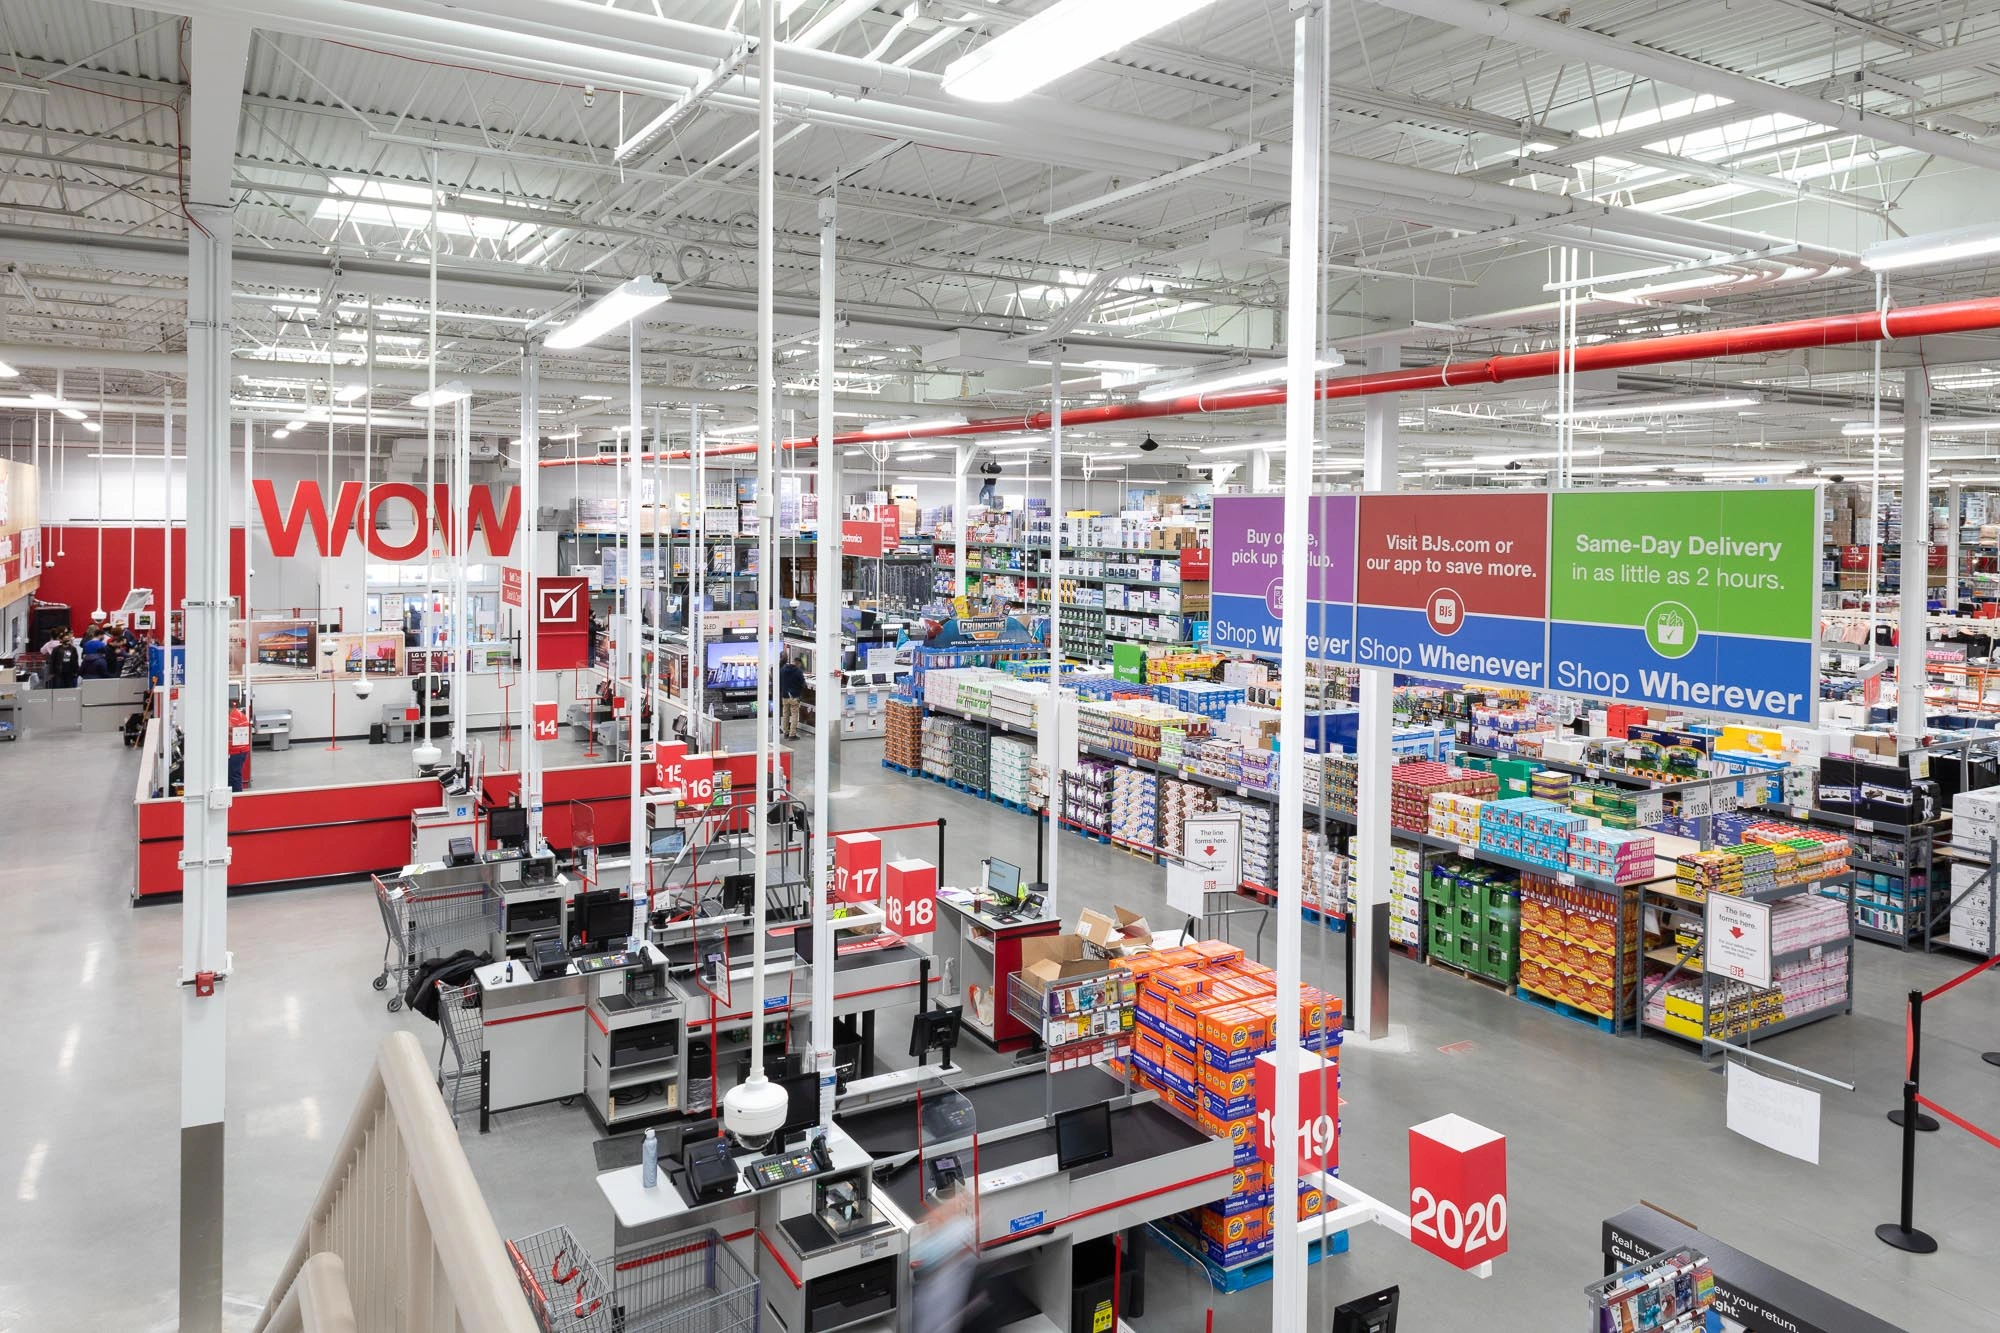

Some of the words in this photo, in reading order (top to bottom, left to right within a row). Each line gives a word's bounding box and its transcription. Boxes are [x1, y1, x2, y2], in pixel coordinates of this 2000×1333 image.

[252, 479, 521, 561] WOW
[1247, 528, 1271, 547] Buy
[1386, 534, 1418, 551] Visit
[1421, 535, 1490, 553] BJs.com
[1495, 540, 1514, 554] or
[1196, 550, 1203, 560] 1
[1231, 548, 1259, 567] pick
[1261, 553, 1278, 568] up
[1576, 534, 1683, 559] Same-Day
[1688, 535, 1782, 562] Delivery
[1366, 557, 1391, 571] our
[1394, 559, 1422, 575] app
[1426, 557, 1442, 573] to
[1446, 561, 1483, 575] save
[1488, 563, 1537, 578] more.
[1571, 562, 1587, 581] in
[1593, 567, 1615, 582] as
[1621, 564, 1661, 584] little
[1666, 570, 1691, 585] as
[1696, 567, 1709, 586] 2
[1717, 567, 1785, 590] hours.
[1216, 620, 1257, 649] Shop
[1359, 636, 1412, 669] Shop
[1418, 643, 1543, 681] Whenever
[1557, 660, 1630, 698] Shop
[1638, 668, 1803, 715] Wherever
[536, 719, 557, 736] 14
[689, 778, 712, 798] 16
[1644, 810, 1662, 823] $16.99
[1690, 802, 1708, 816] $13.99
[836, 865, 848, 893] 17
[852, 867, 879, 894] 17
[886, 895, 902, 926] 18
[904, 897, 934, 927] 18
[1725, 906, 1738, 915] The
[1739, 910, 1752, 919] line
[1719, 914, 1739, 926] forms
[1739, 919, 1758, 930] here.
[1232, 1031, 1247, 1045] Tide
[1231, 1079, 1245, 1093] Tide
[1230, 1125, 1245, 1138] Tide
[1297, 1114, 1335, 1160] 19
[1306, 1195, 1320, 1210] Tide
[1229, 1222, 1243, 1237] Tide
[1411, 1186, 1464, 1249] 20
[1464, 1193, 1507, 1253] 20
[1611, 1231, 1633, 1250] Real
[1634, 1242, 1650, 1259] tax
[1732, 1291, 1759, 1314] your
